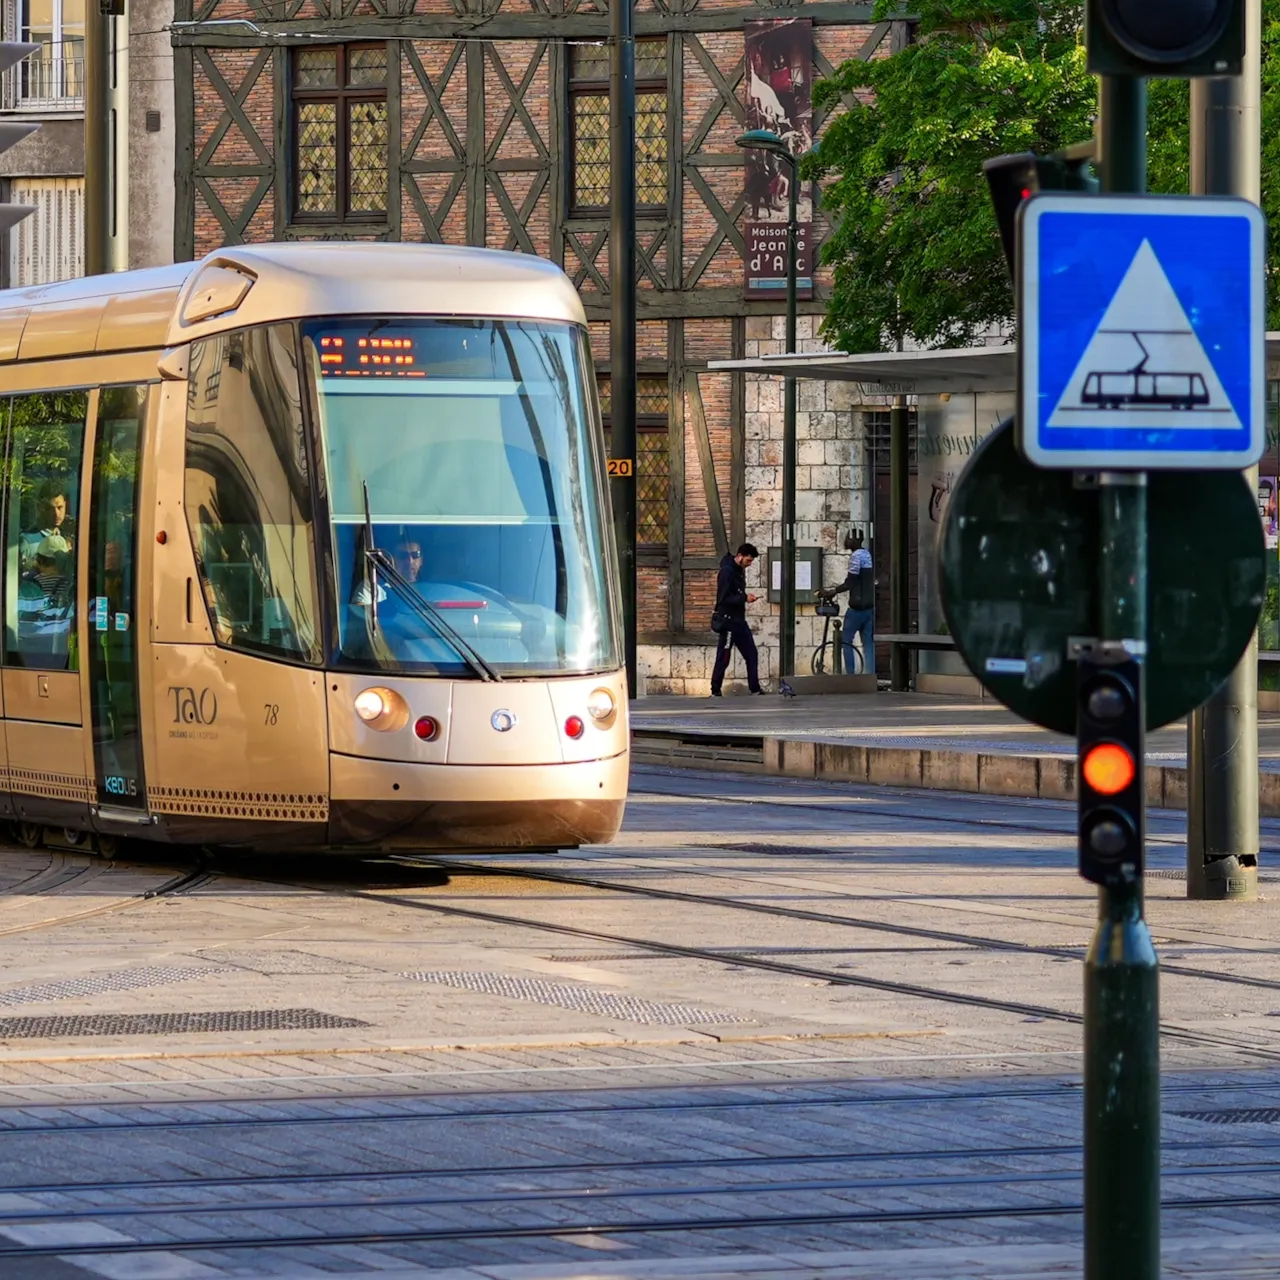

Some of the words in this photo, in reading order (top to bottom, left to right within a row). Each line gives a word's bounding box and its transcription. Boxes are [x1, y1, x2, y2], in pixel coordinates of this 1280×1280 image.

[751, 226, 788, 236] Maison
[751, 240, 805, 251] Jeane
[750, 254, 805, 271] d'Ac
[608, 461, 629, 475] 20
[264, 704, 280, 726] 78
